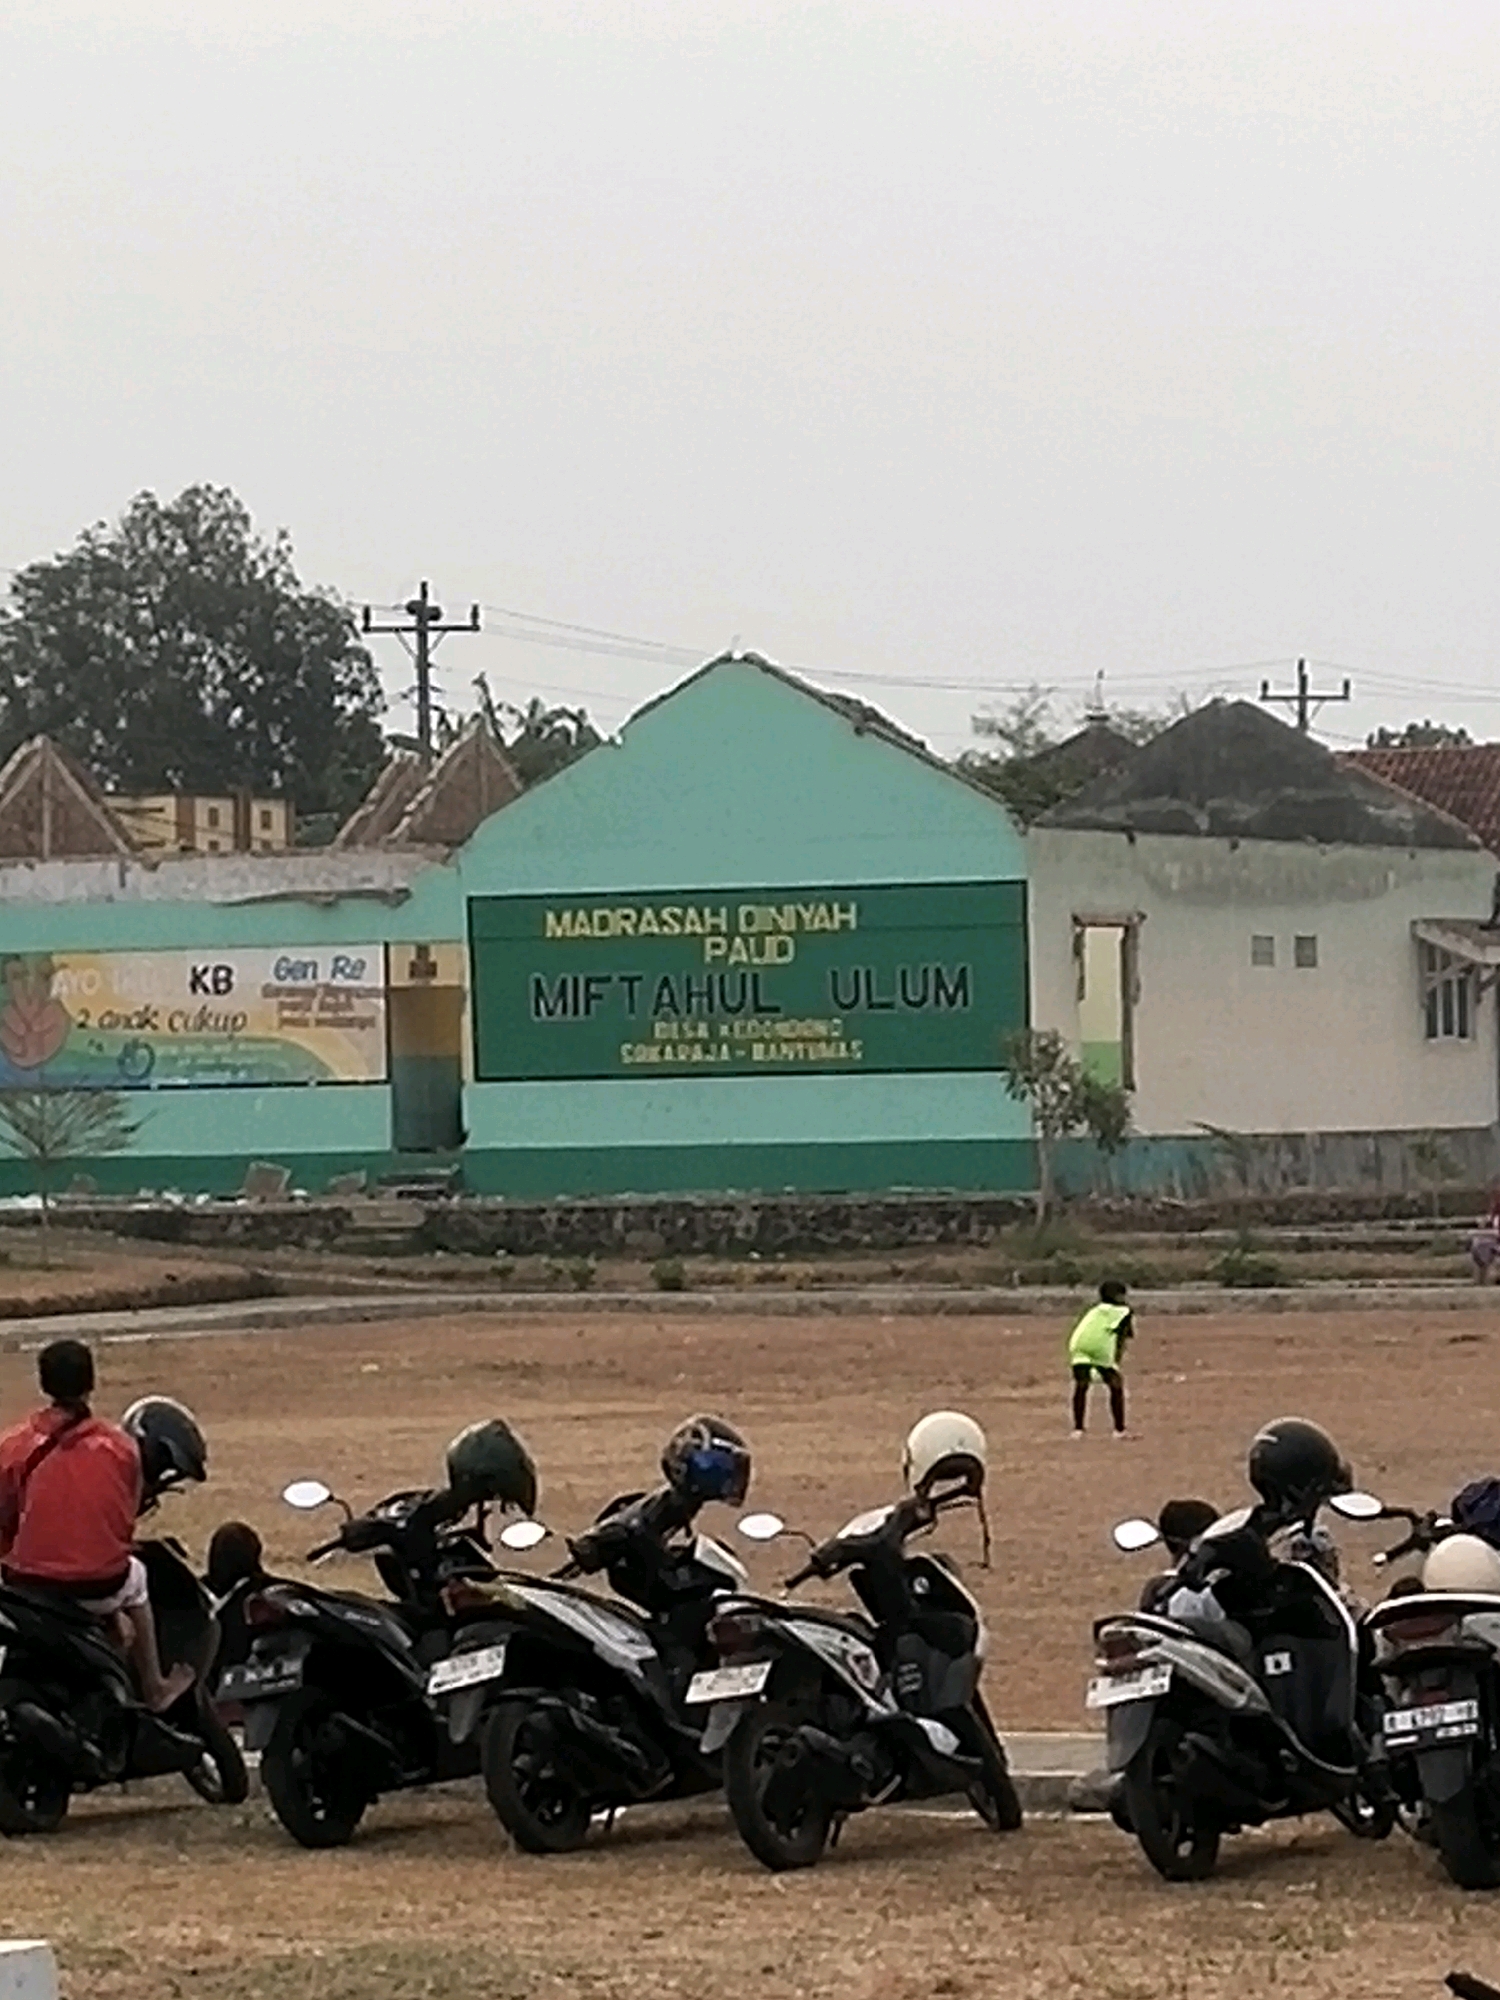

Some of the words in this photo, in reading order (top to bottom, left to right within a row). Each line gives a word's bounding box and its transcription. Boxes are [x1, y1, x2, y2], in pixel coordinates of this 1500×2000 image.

[545, 906, 728, 938] MADRASAH
[738, 902, 858, 934] DINIYAH
[704, 935, 795, 965] PAUD
[188, 964, 234, 996] KB
[532, 970, 782, 1019] MIFTAHUL
[830, 965, 970, 1011] ULUM
[77, 1007, 91, 1029] 2
